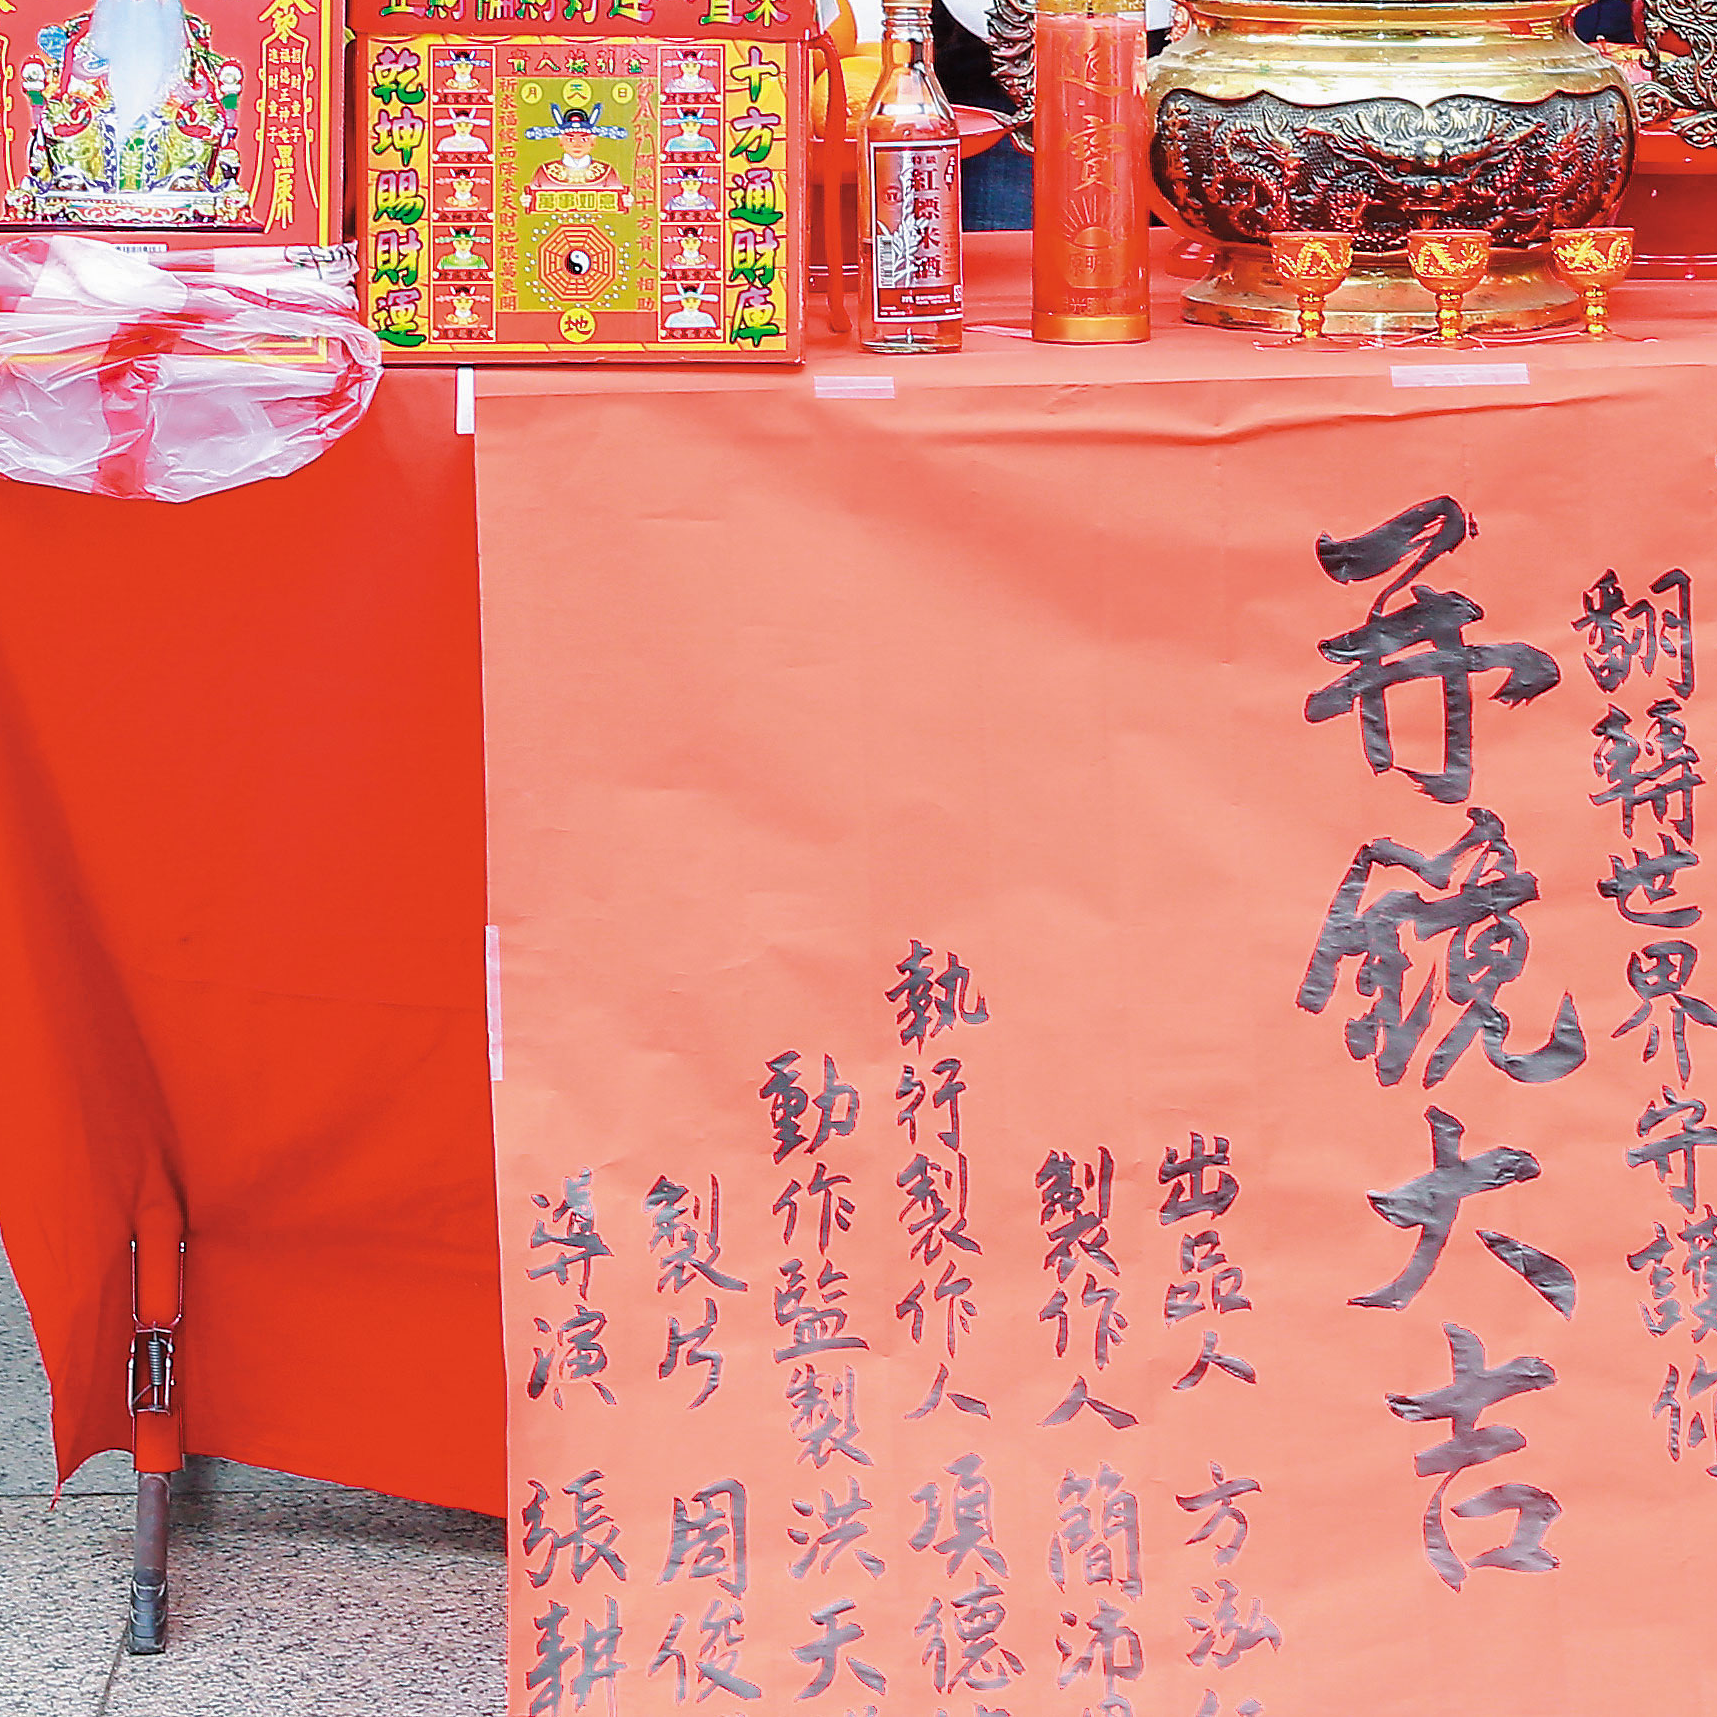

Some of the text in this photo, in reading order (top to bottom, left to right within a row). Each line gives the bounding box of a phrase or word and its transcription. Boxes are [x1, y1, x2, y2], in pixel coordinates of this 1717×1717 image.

[371, 45, 428, 347] 乾坤賜財運
[729, 45, 784, 348] 十方通財庫
[1057, 26, 1132, 195] 進寶
[563, 314, 592, 336] 地
[527, 1168, 615, 1405] 導演
[645, 1177, 746, 1408] 製片
[762, 1051, 886, 1717] 動作監製 洪天
[886, 940, 1023, 1717] 執行製作人 項德
[1160, 1133, 1255, 1391] 出品人
[1037, 1150, 1143, 1717] 製作人 簡沛
